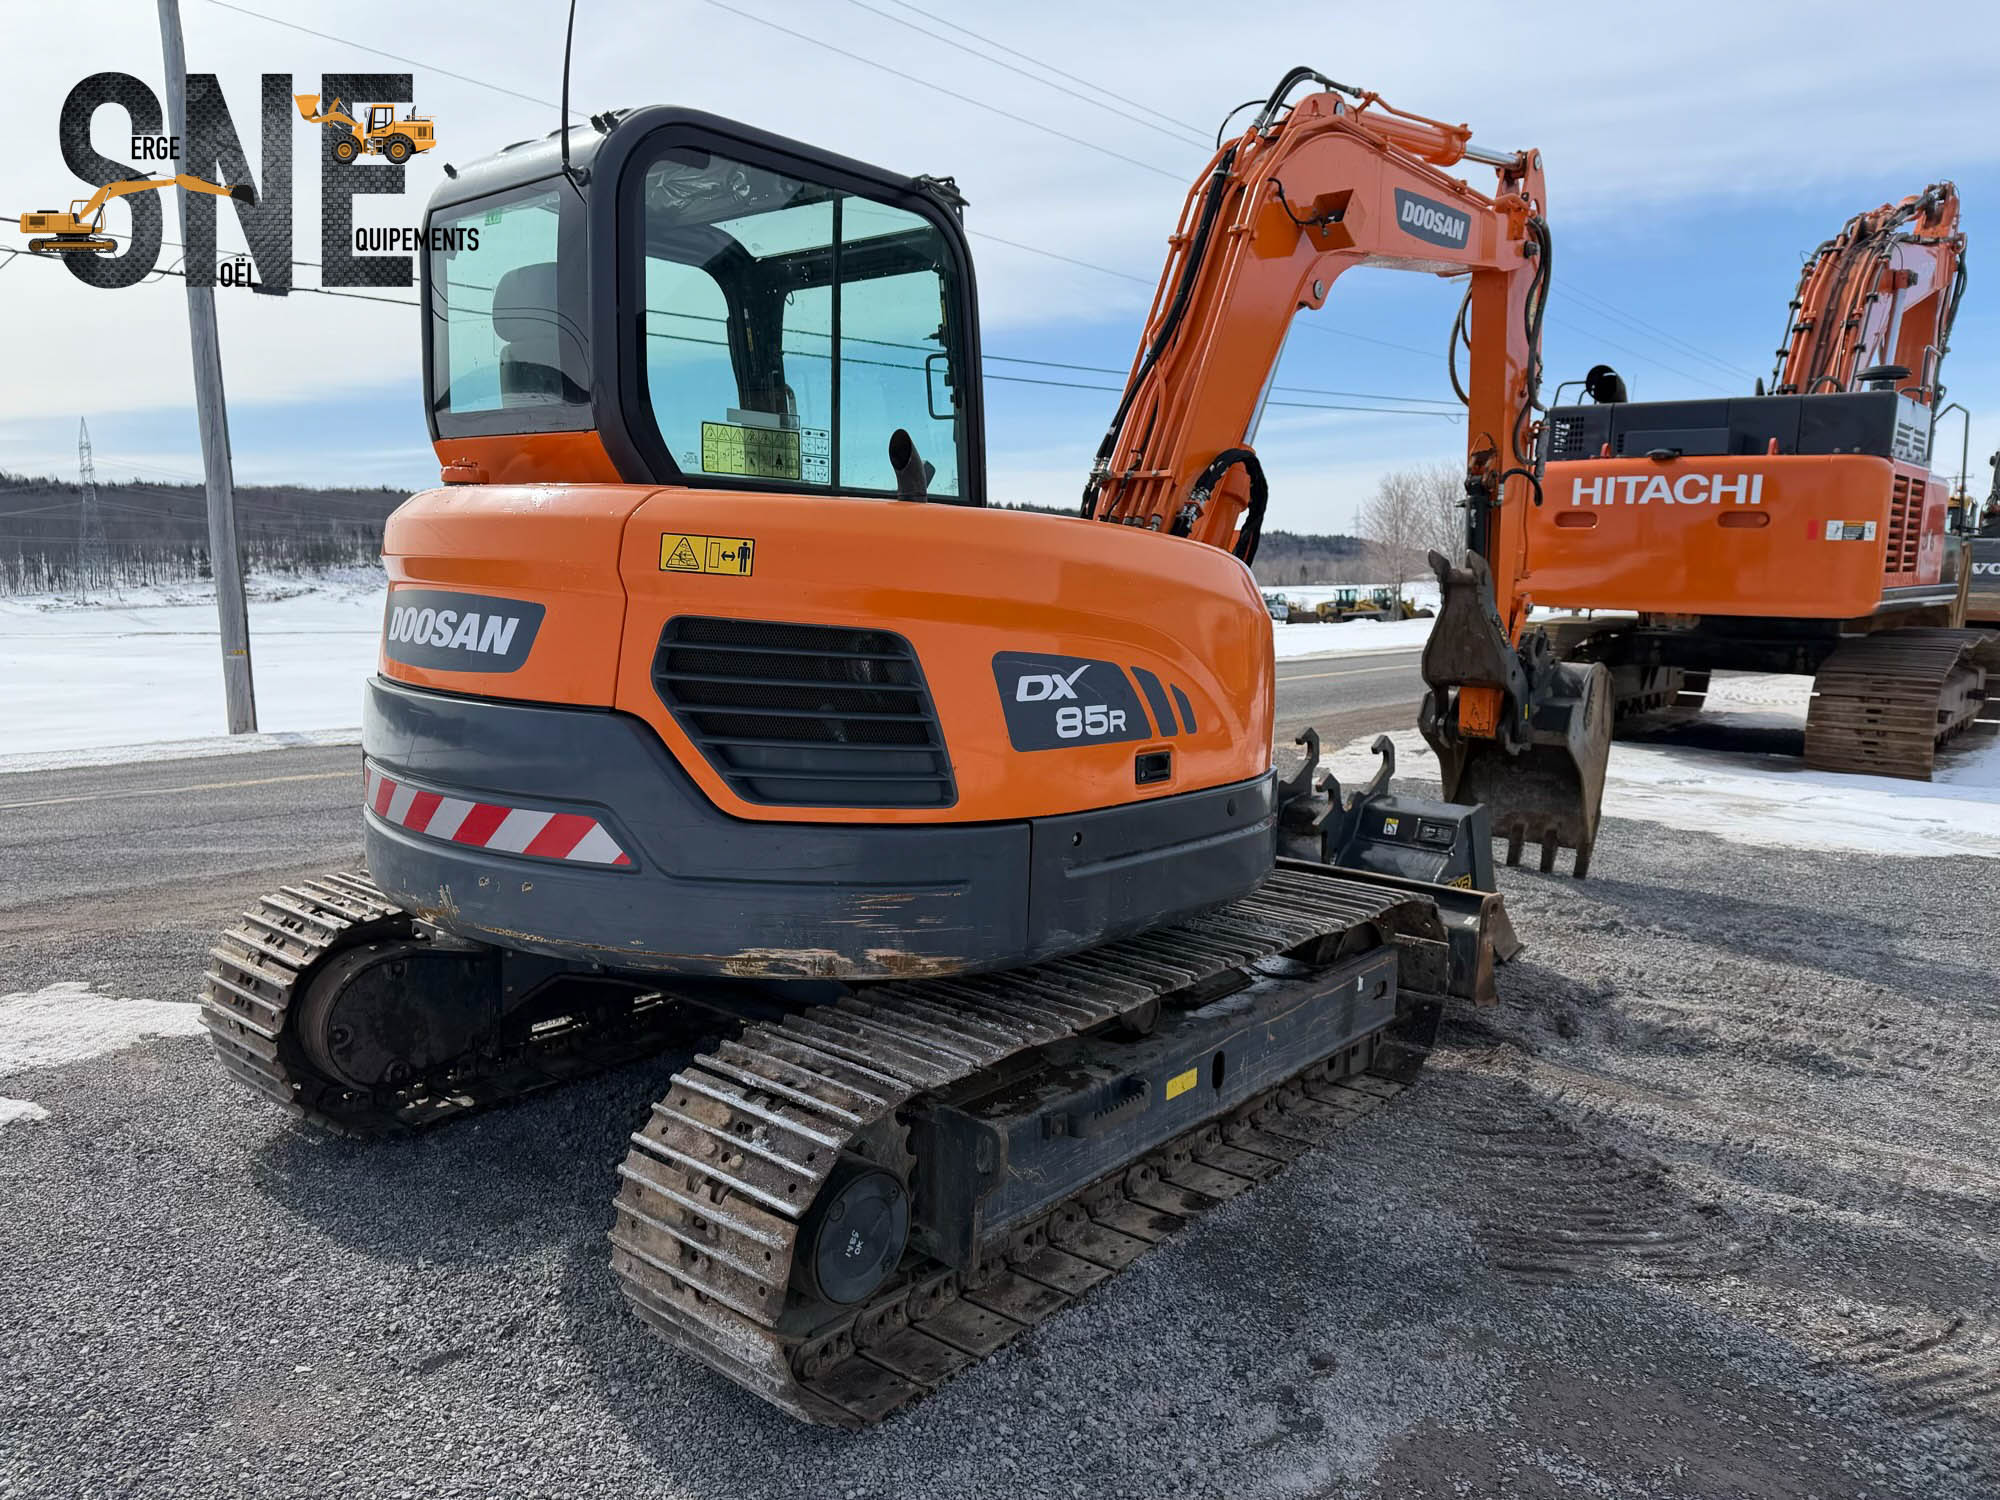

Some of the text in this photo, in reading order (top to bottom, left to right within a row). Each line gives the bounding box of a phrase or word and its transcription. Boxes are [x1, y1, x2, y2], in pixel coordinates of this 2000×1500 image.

[1401, 200, 1465, 241] DOOSAN
[1572, 474, 1764, 506] HITACHI
[389, 607, 519, 655] DOOSAN
[1016, 665, 1091, 701] DX
[1056, 705, 1127, 739] 85R
